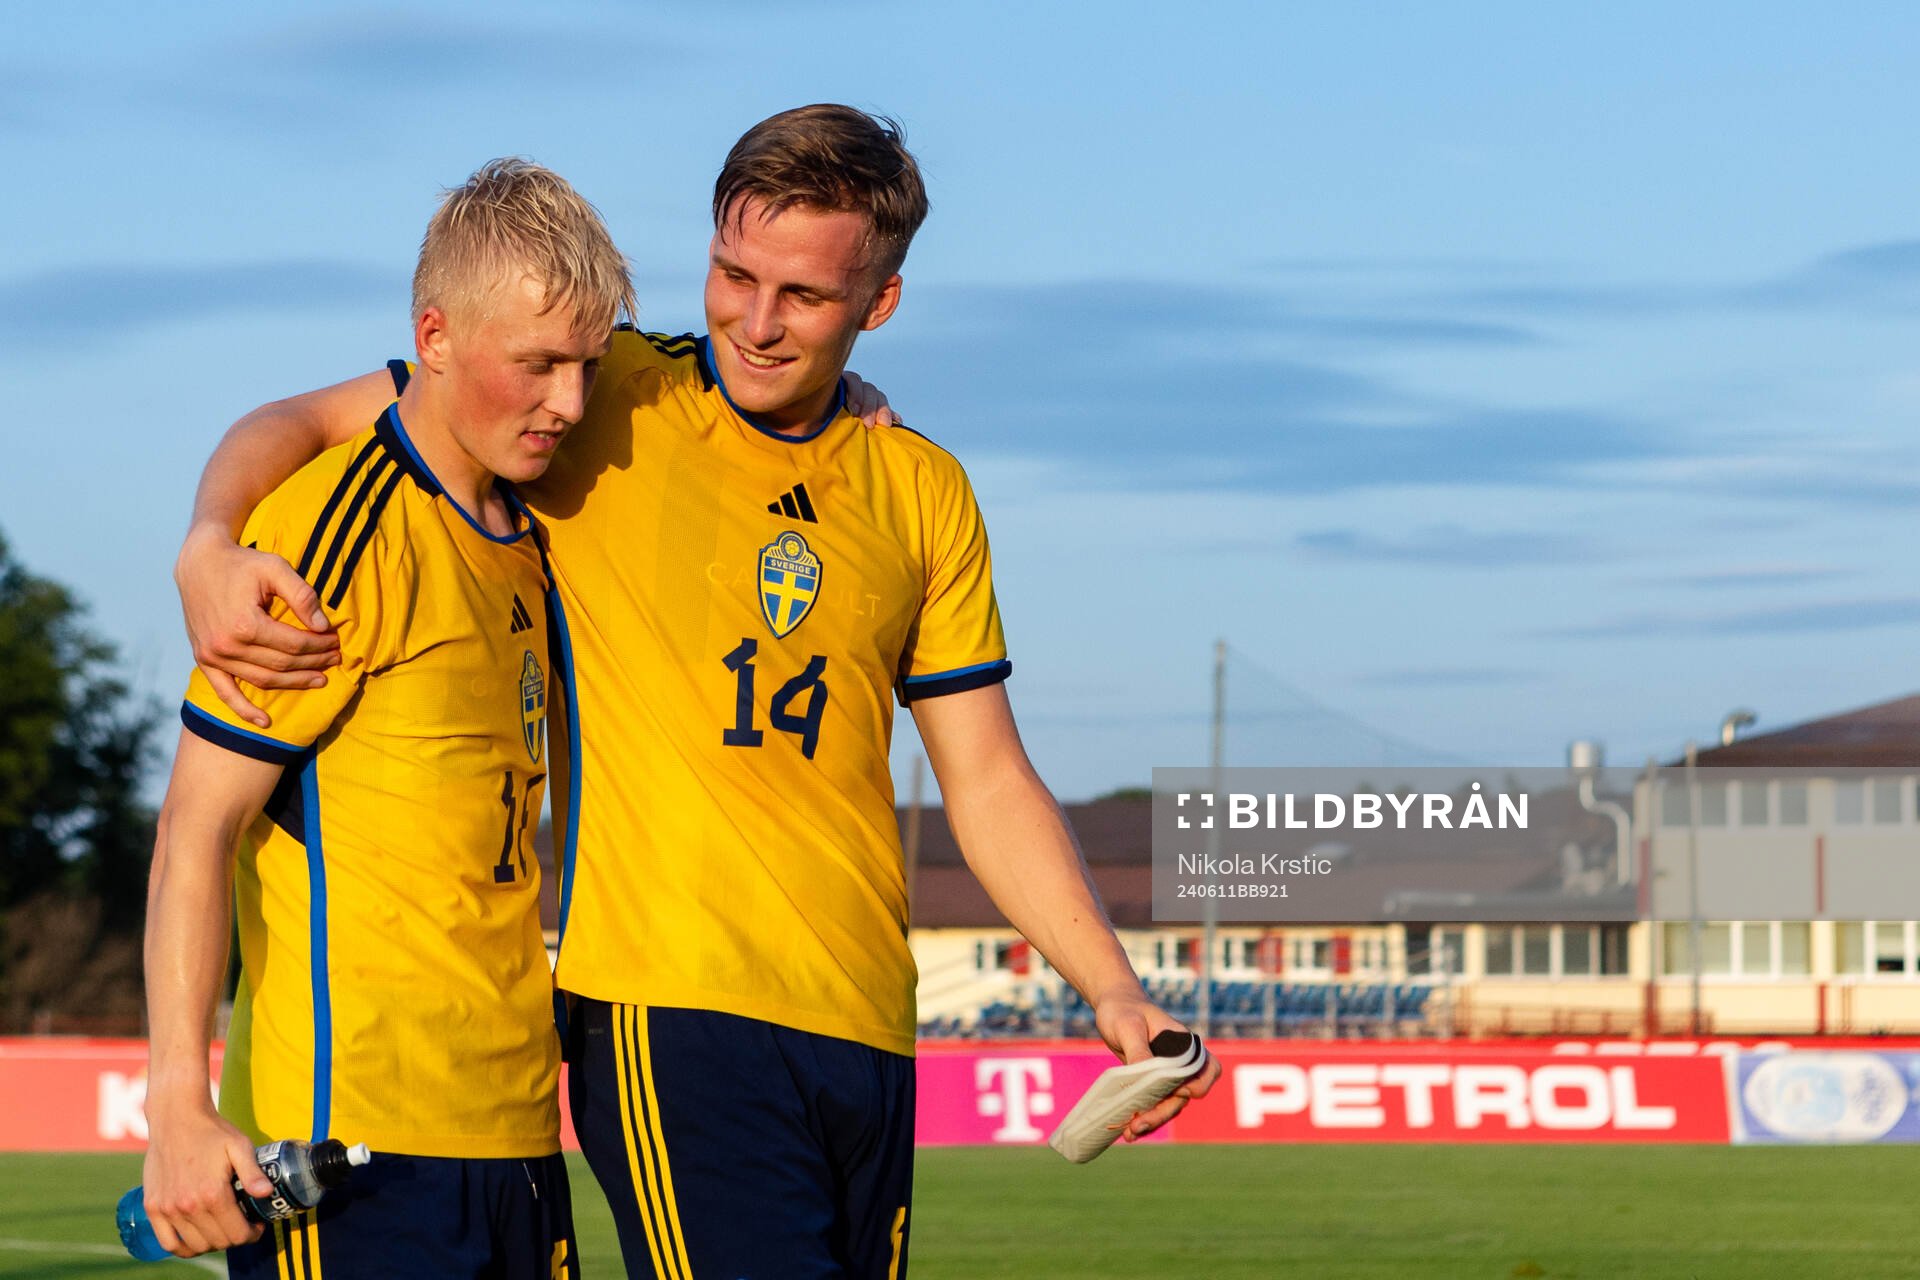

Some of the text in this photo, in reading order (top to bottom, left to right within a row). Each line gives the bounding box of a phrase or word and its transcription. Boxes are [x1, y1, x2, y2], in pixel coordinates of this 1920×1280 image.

[771, 559, 811, 575] SVERIGE
[722, 637, 828, 760] 14
[1233, 1063, 1677, 1129] PETROL
